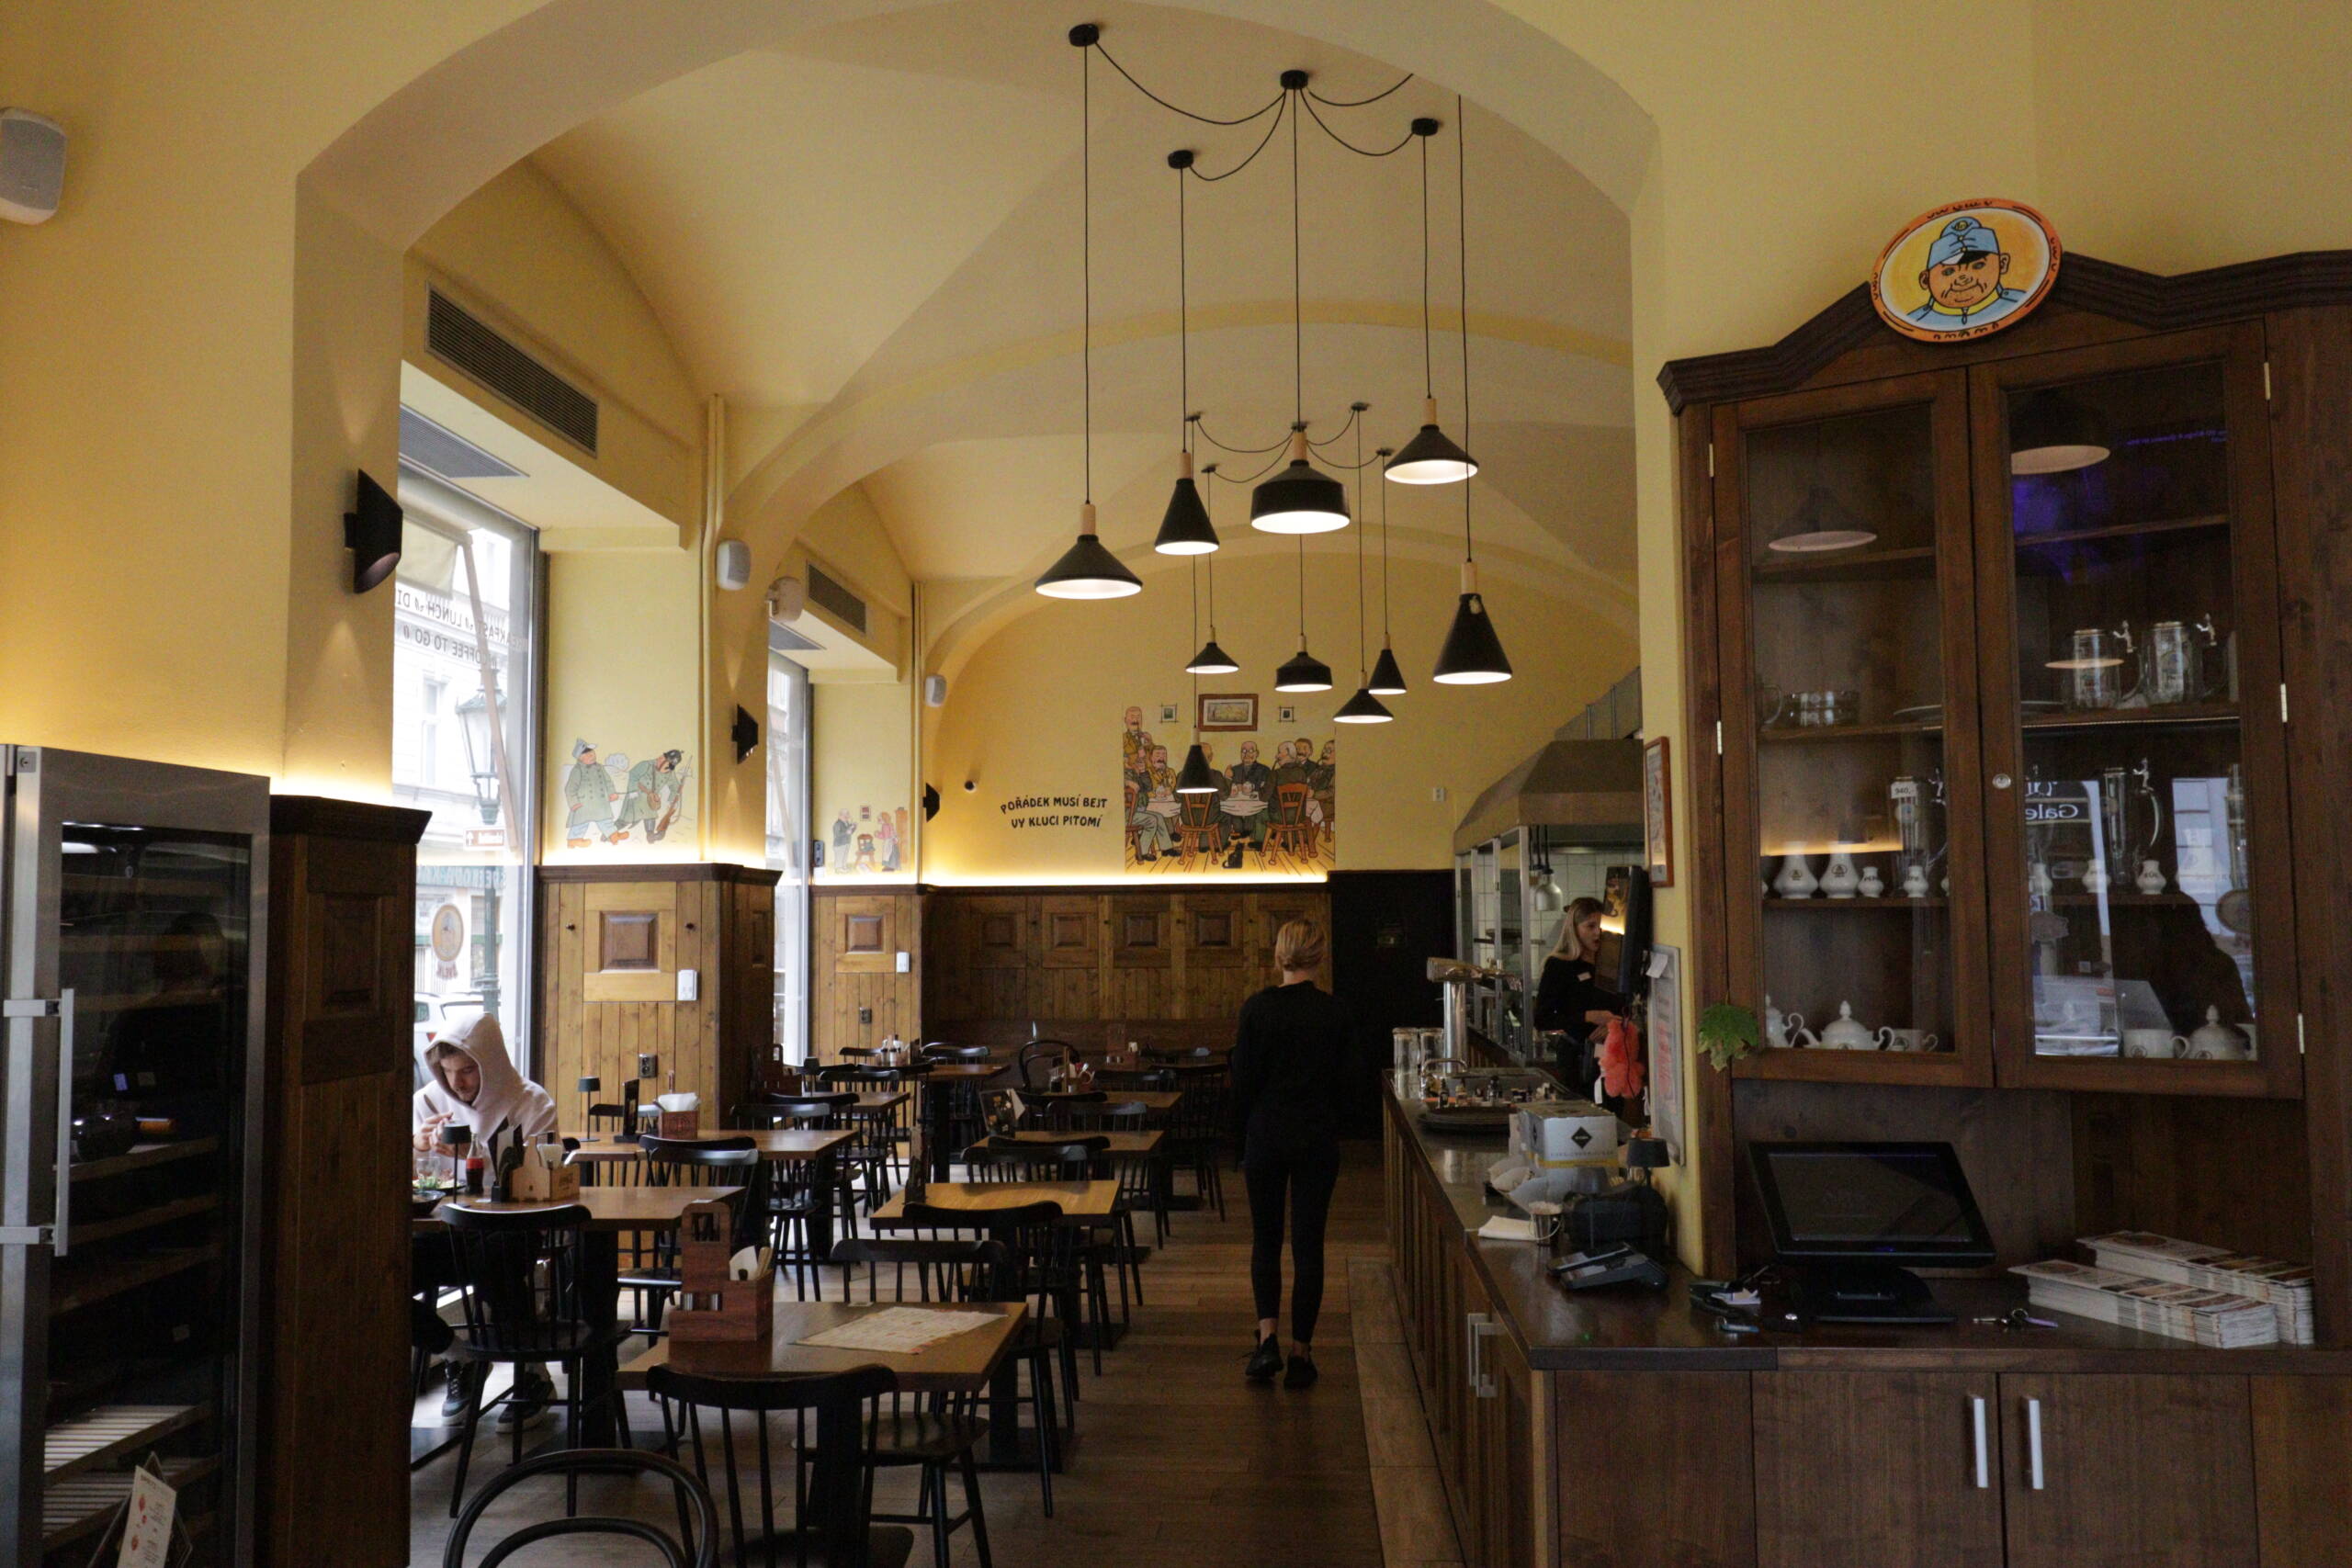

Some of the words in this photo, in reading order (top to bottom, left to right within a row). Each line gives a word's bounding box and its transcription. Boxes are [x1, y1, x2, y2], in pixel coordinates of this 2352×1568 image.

[1001, 795, 1050, 815] POŘÁDEK
[1053, 794, 1080, 807] MUSÍ
[1083, 797, 1108, 808] BEJT
[1029, 816, 1059, 827] KLUCI
[1063, 815, 1102, 828] PITOMÍ
